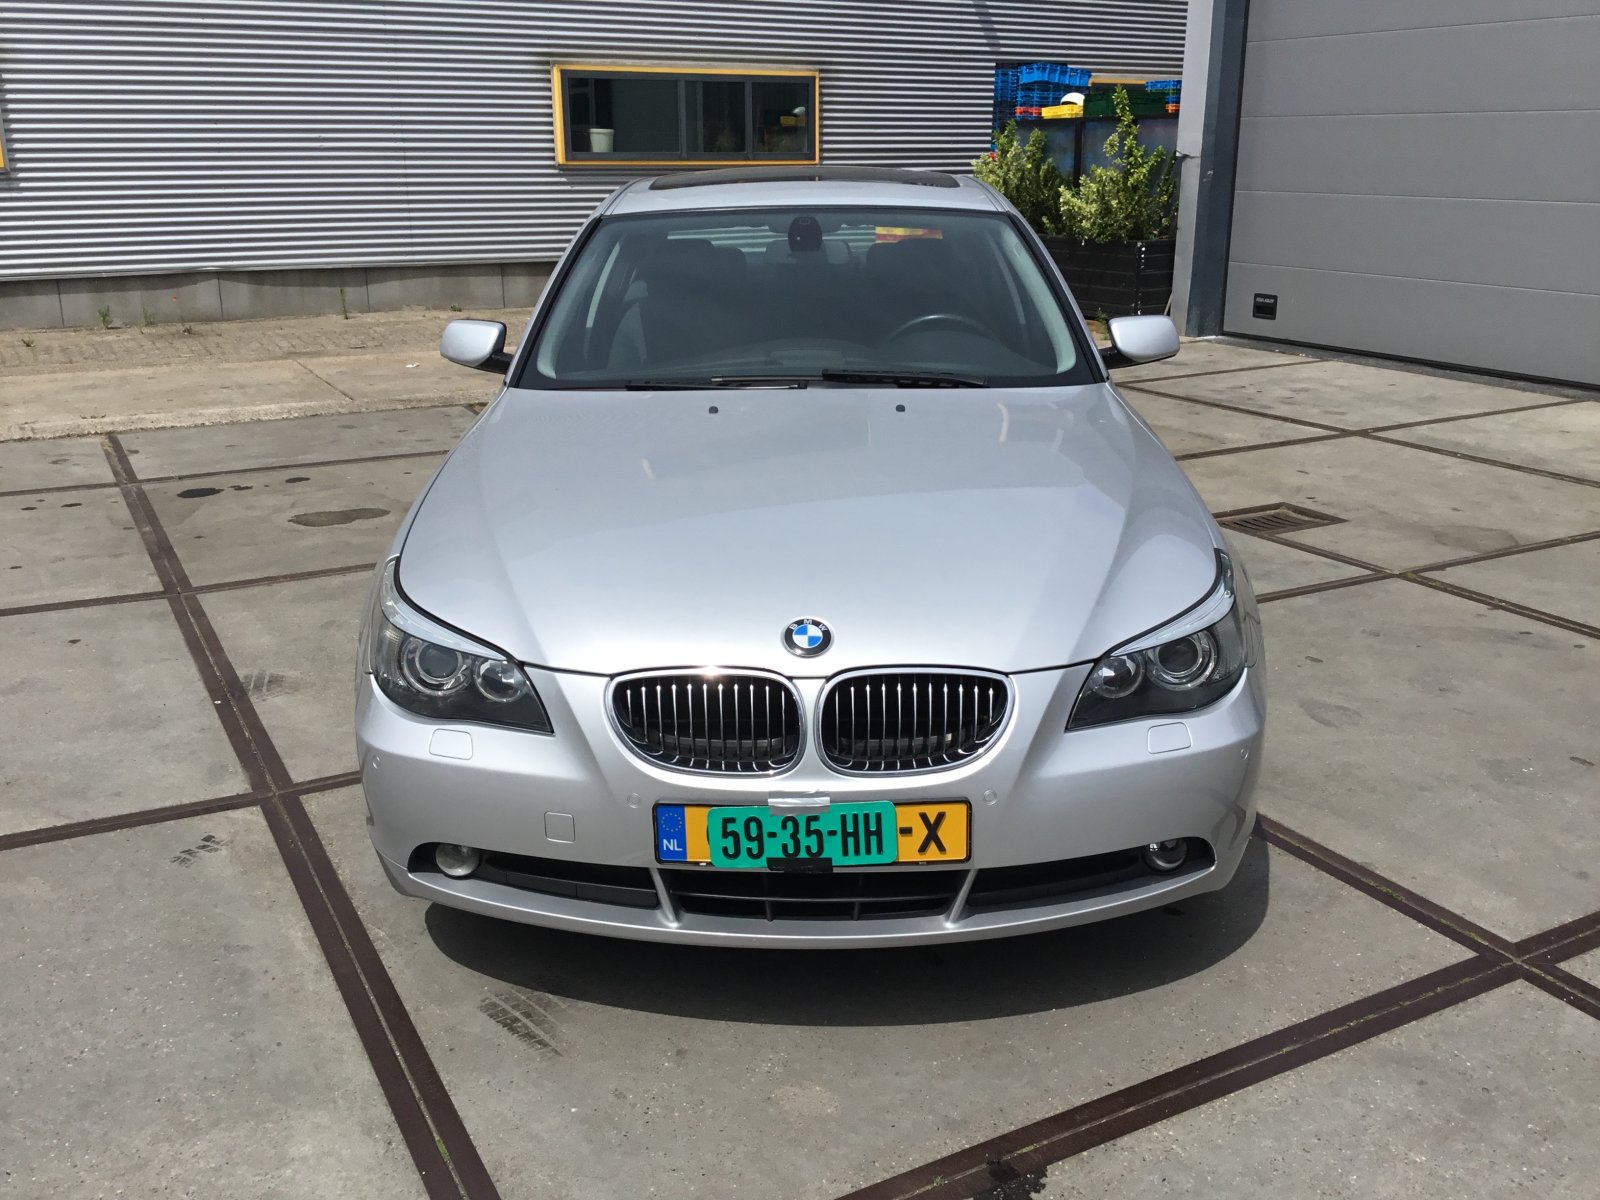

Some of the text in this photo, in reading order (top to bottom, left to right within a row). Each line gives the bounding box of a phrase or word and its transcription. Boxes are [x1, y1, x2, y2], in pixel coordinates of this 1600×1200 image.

[789, 618, 828, 631] BMW
[721, 812, 884, 860] 59-35-HH
[663, 838, 683, 851] NL
